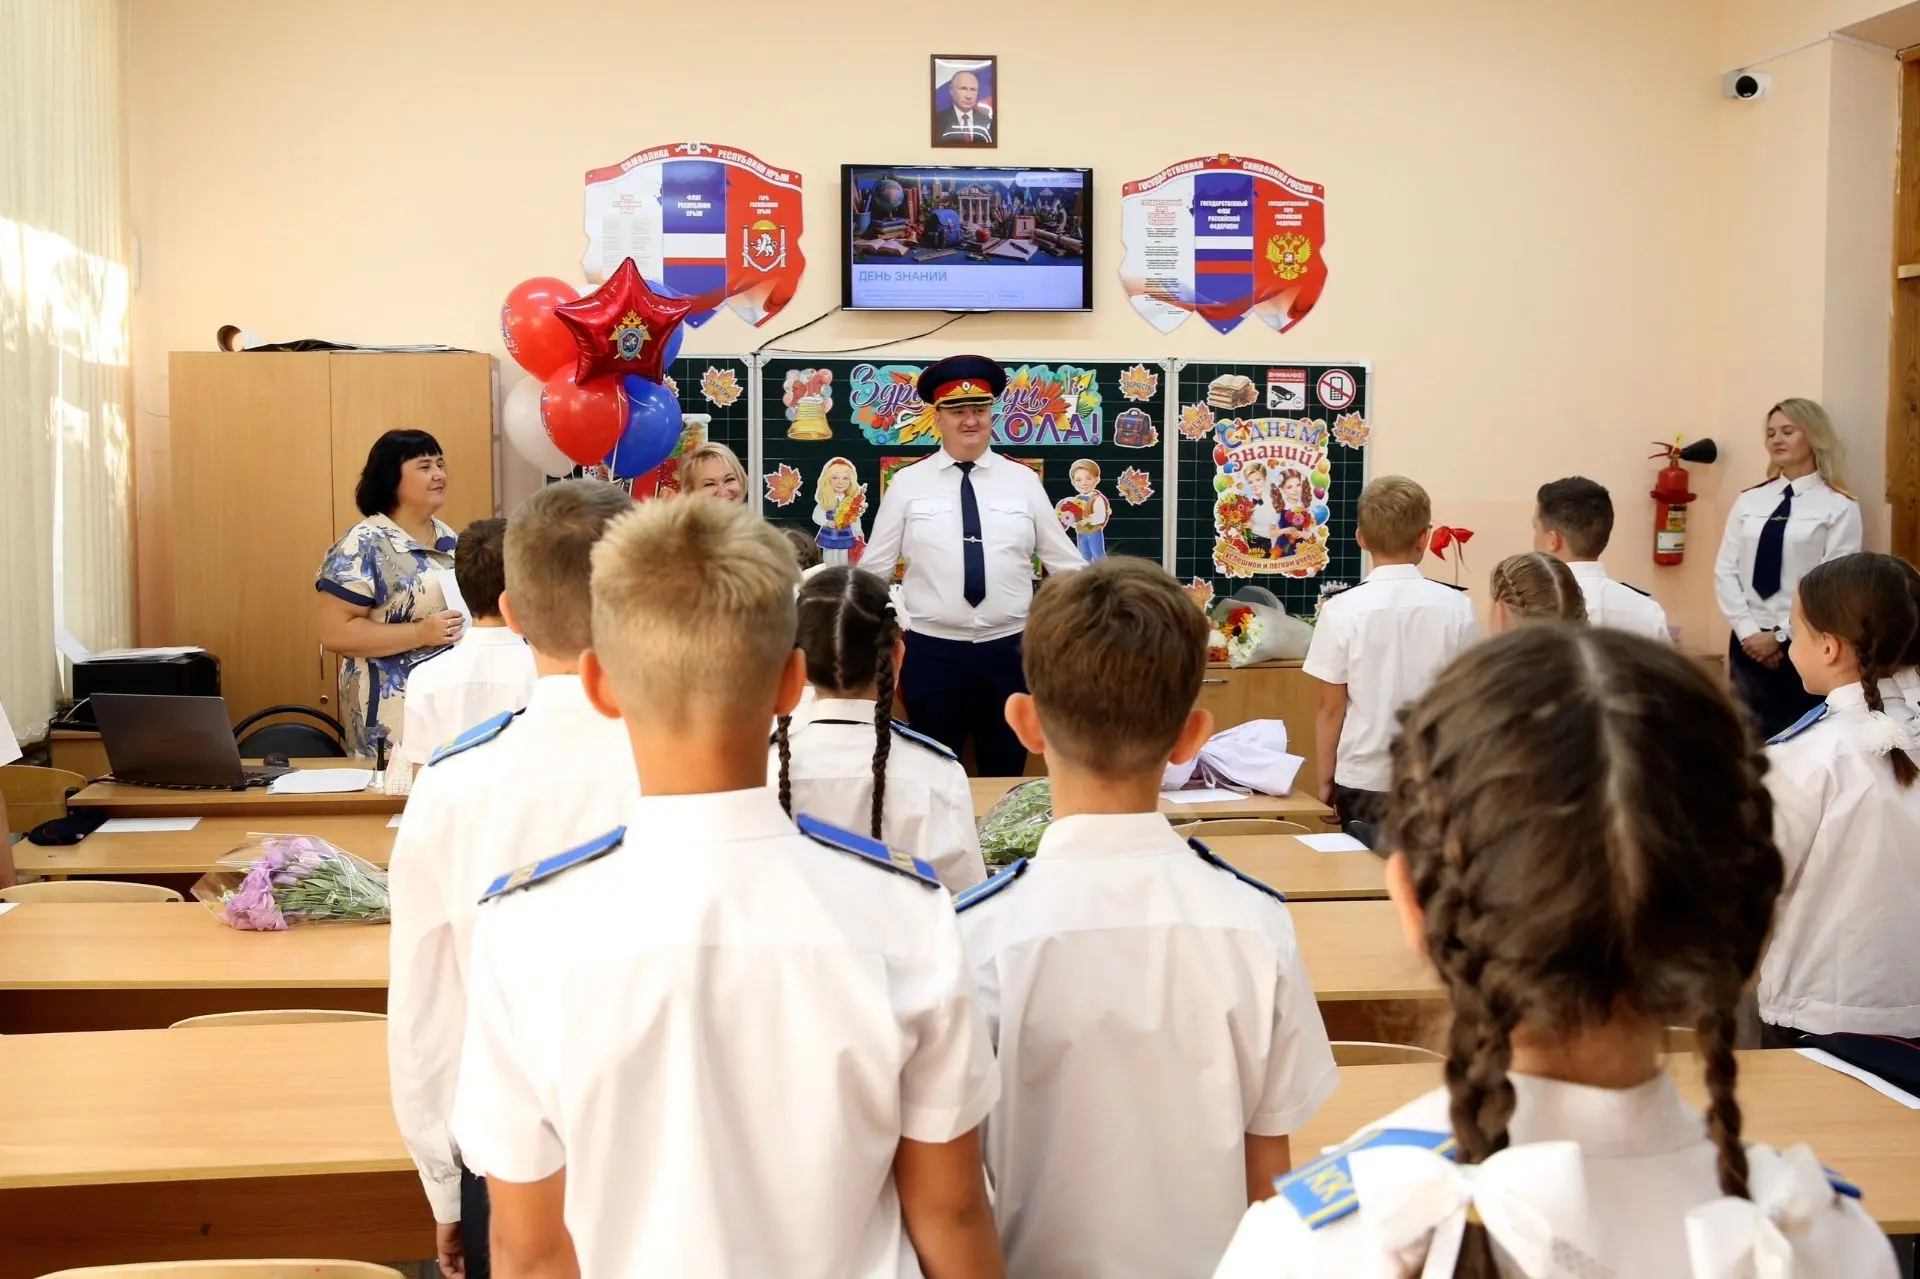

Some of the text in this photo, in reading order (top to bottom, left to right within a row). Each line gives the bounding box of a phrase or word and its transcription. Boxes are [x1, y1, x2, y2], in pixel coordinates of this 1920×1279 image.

[621, 149, 670, 173] СИМВОЛИКА
[717, 149, 790, 183] РЕСПУБЛИКИ КРЫМ
[1138, 160, 1204, 191] ГОСУДАРСТВЕННАЯ
[1242, 160, 1314, 194] СИМВОЛИКА РОССИИ
[858, 269, 948, 283] ДЕНЬ ЗНАНИЙ
[851, 365, 1050, 417] Здруй,
[990, 412, 1099, 445] КОЛА!
[1187, 414, 1209, 433] МЕЧТА
[1216, 420, 1325, 449] С ДНЕМ
